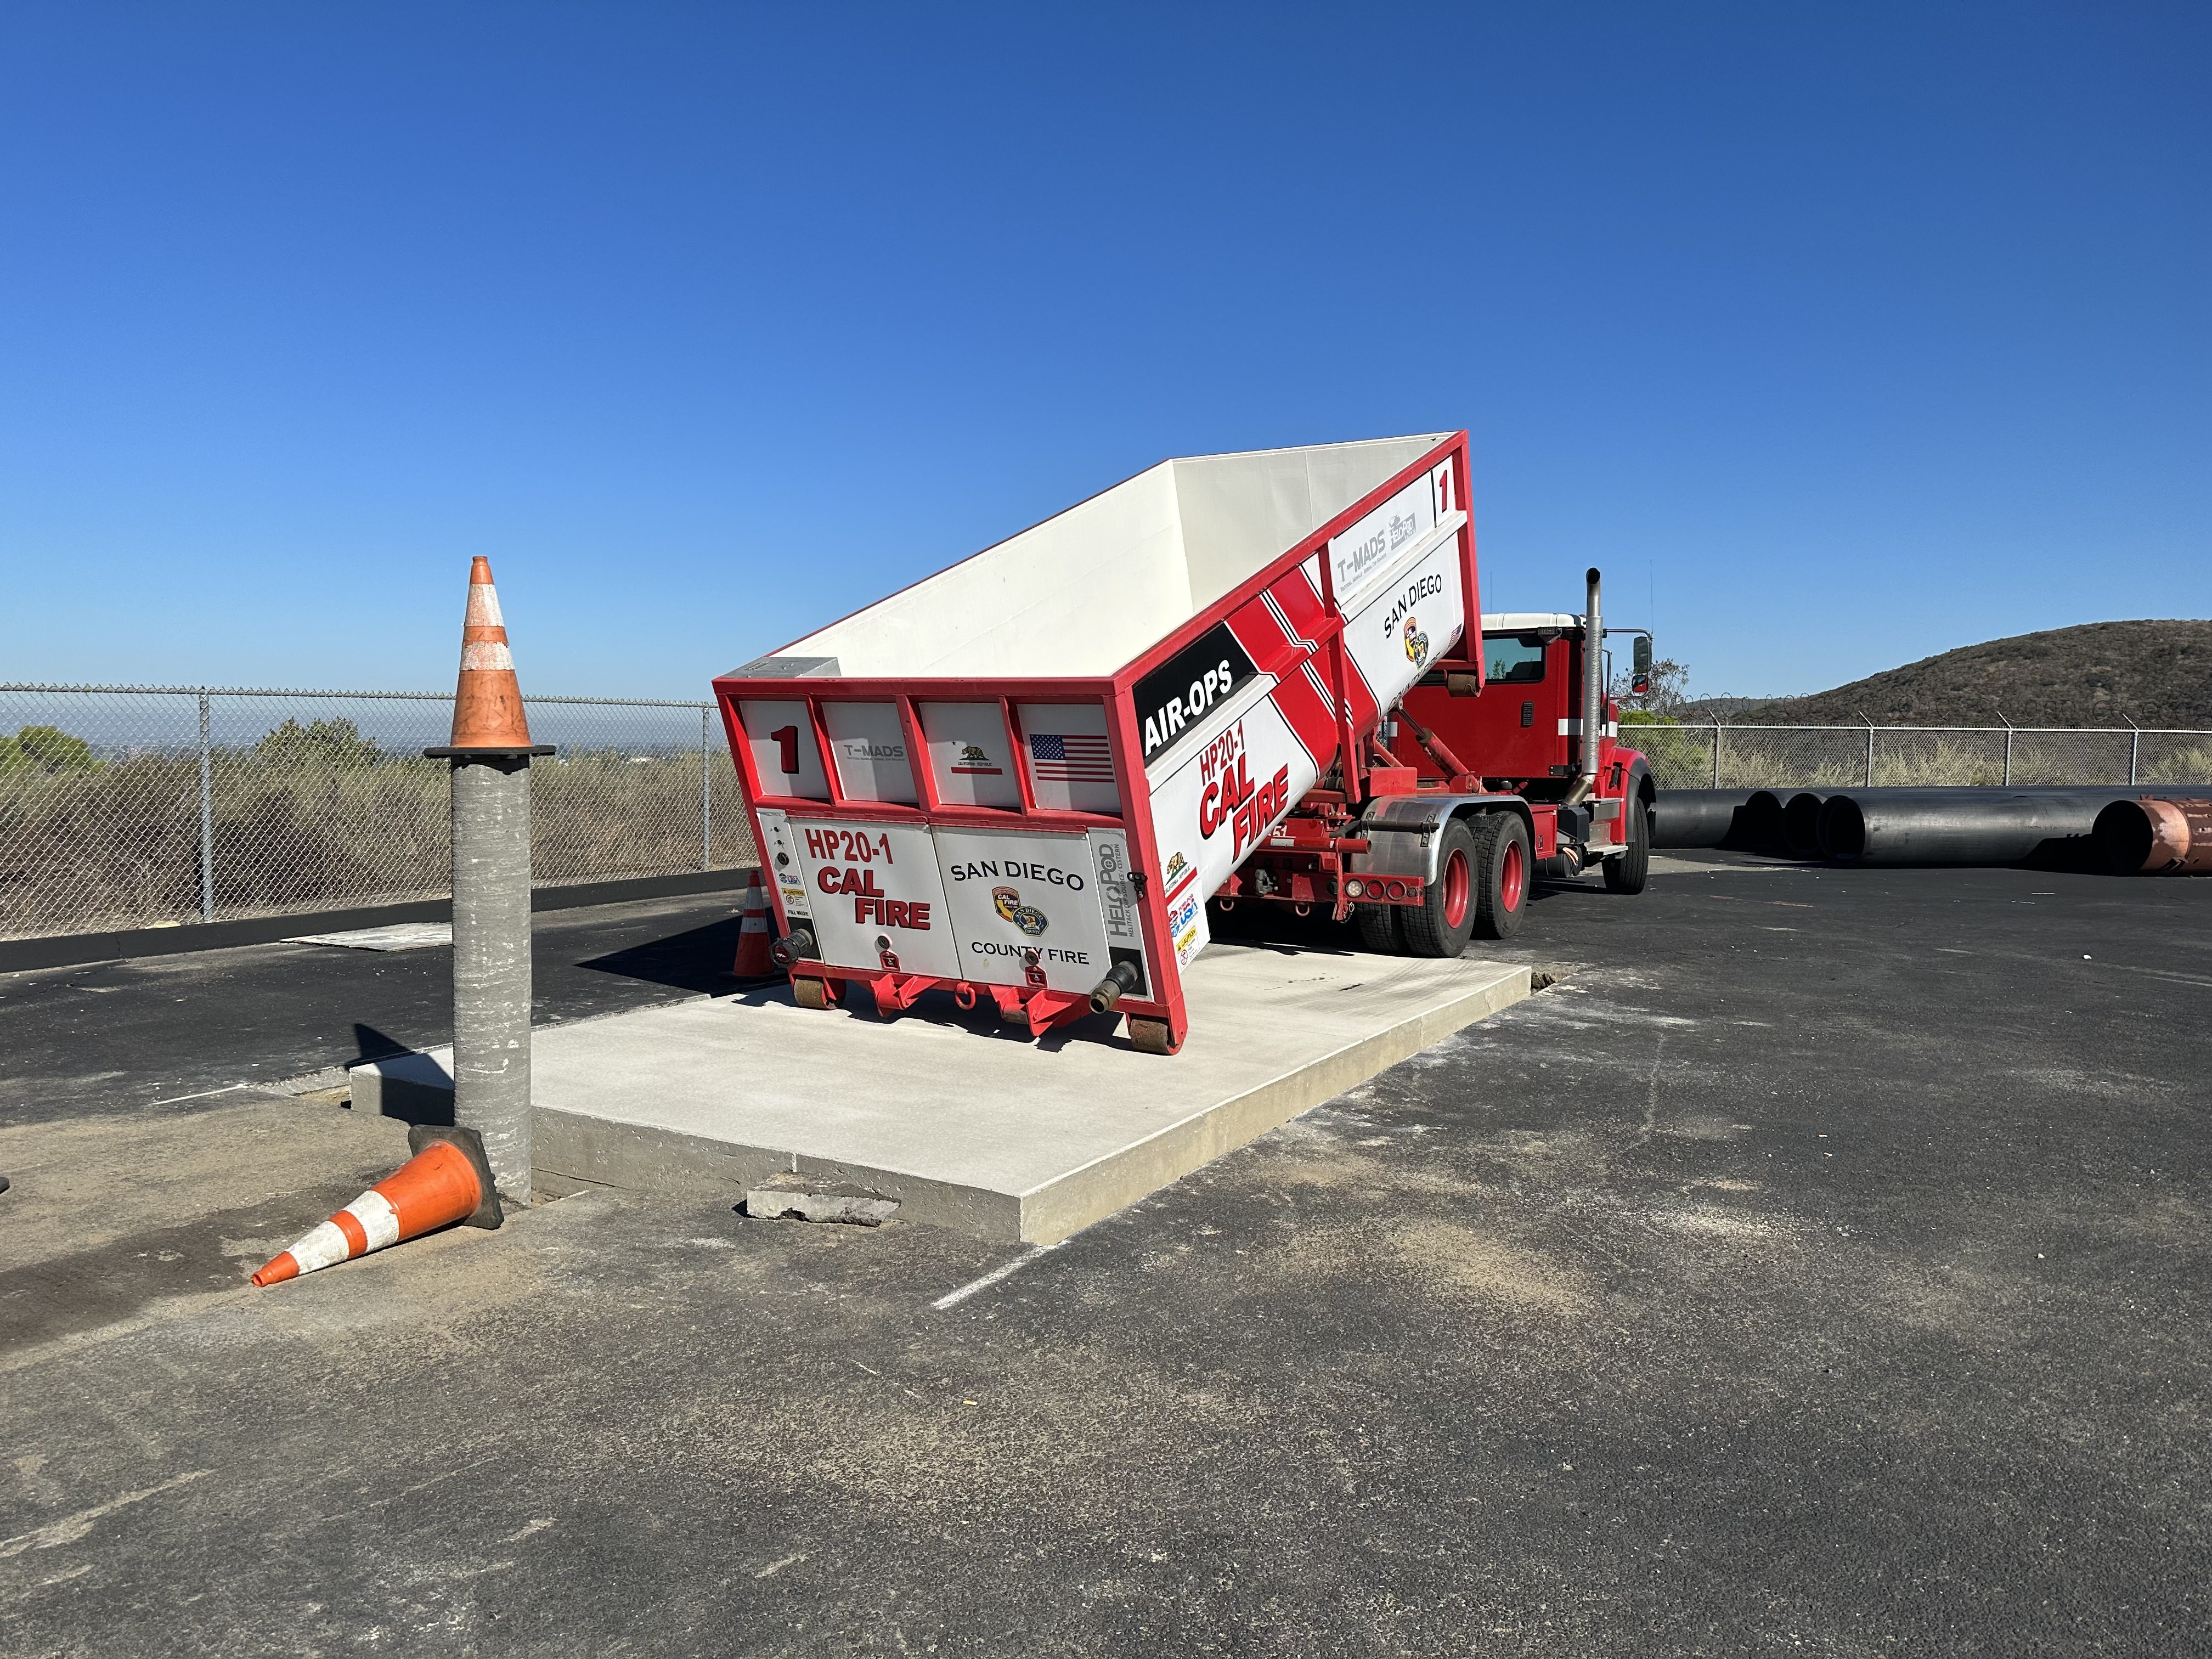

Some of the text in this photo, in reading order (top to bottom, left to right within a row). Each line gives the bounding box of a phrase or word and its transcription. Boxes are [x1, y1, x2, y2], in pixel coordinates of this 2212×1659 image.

[1439, 470, 1447, 513] 1
[1338, 529, 1385, 582] T-MADS
[1384, 574, 1441, 639] SAN DIEGO
[1145, 659, 1232, 757] AIR-OPS
[771, 725, 799, 774] 1
[844, 744, 904, 757] T-MADS
[1199, 719, 1245, 787] HP20-1
[1200, 751, 1255, 840] CAL
[1232, 763, 1288, 865] FIRE
[805, 828, 894, 865] HP20-1
[1114, 844, 1123, 869] CISTERN
[817, 866, 884, 898] CAL
[951, 860, 1084, 891] SAN DIEGO
[1119, 873, 1128, 897] SOURCE
[855, 897, 931, 930] FIRE
[1015, 908, 1043, 921] SAN DIEGO
[1125, 909, 1134, 937] HELITACK
[1181, 928, 1195, 947] CAUTION
[1047, 949, 1090, 965] FIRE
